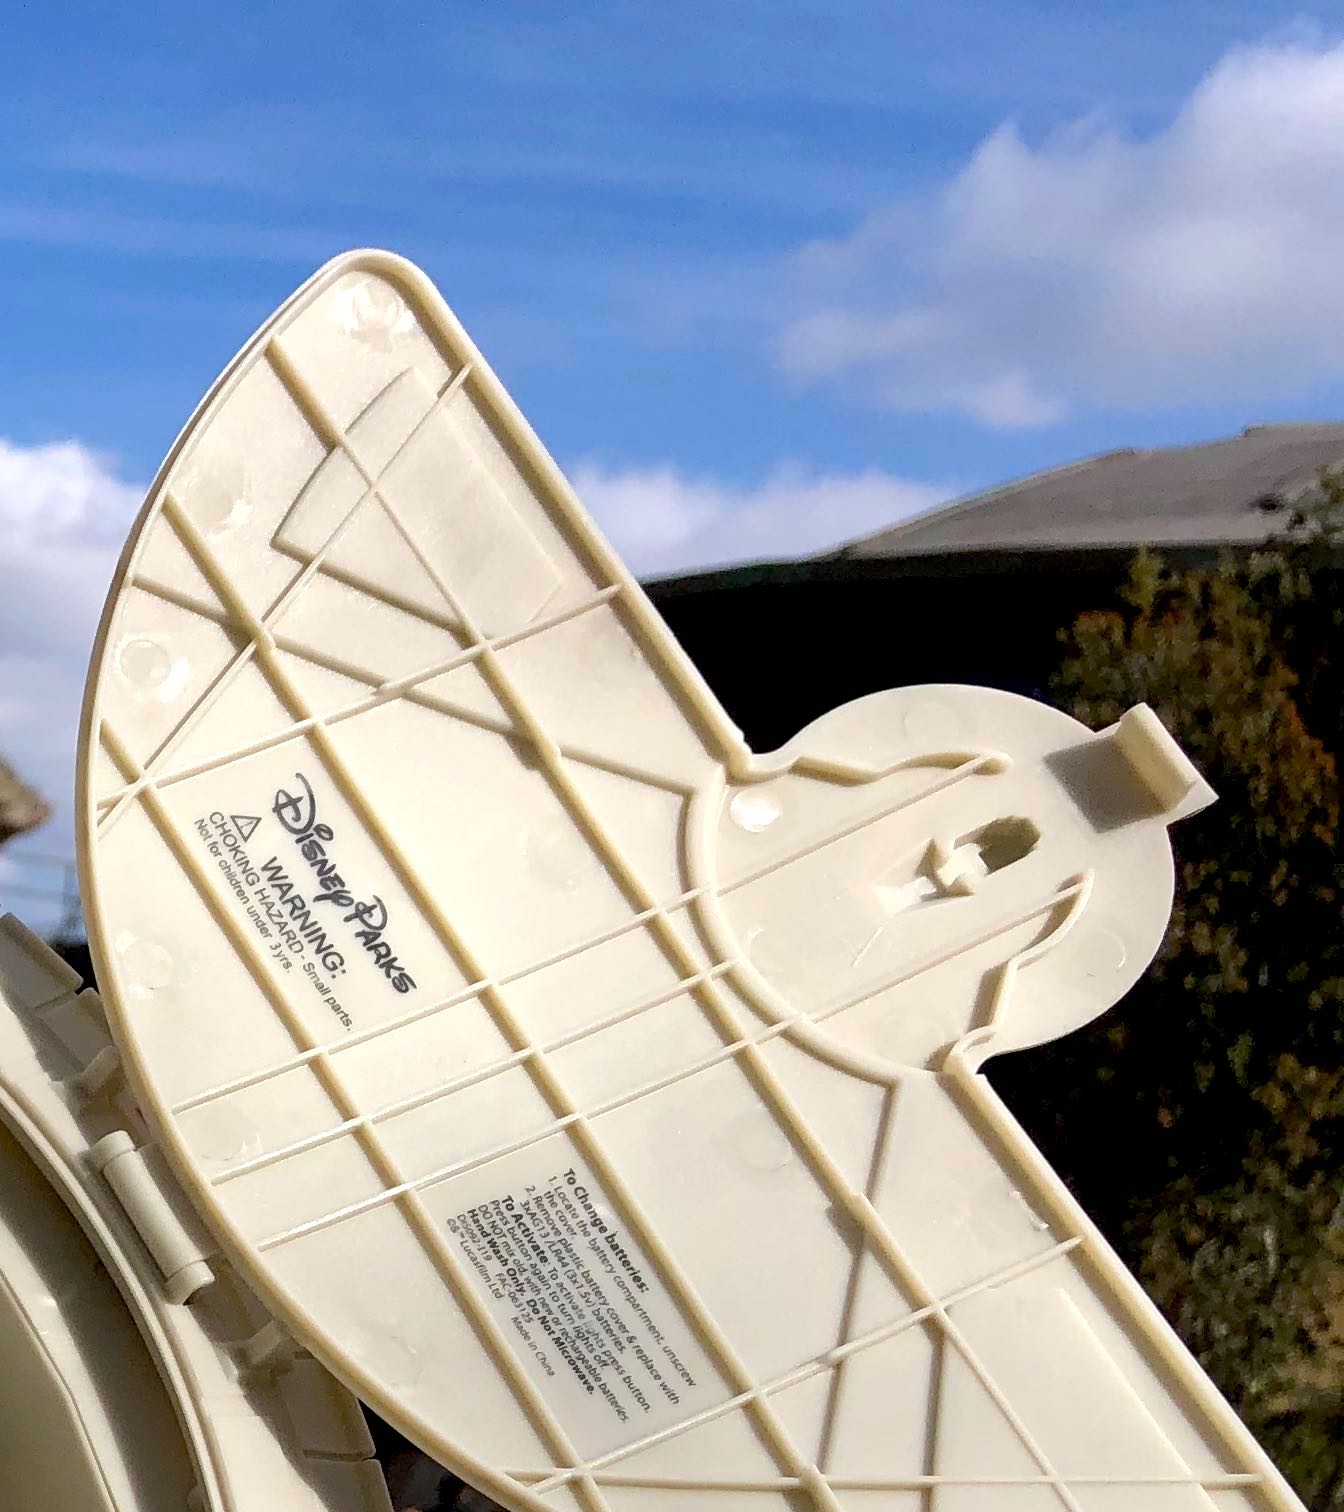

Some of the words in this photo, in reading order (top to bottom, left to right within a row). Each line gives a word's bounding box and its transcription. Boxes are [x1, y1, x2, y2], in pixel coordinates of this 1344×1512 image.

[193, 818, 213, 841] Not
[206, 840, 223, 859] for
[216, 857, 251, 905] children
[245, 904, 274, 939] under
[271, 949, 296, 974] yrs.
[206, 809, 262, 887] CHOKING
[252, 886, 305, 955] HAZARD
[301, 960, 331, 996] Small
[322, 994, 357, 1033] parts.
[258, 855, 351, 980] WARNING:
[541, 1190, 560, 1209] the
[560, 1167, 580, 1186] To
[568, 1184, 612, 1235] Change
[458, 1238, 494, 1283] Lucasfilm
[509, 1315, 533, 1341] Made
[533, 1350, 557, 1376] China
[465, 1208, 492, 1238] Hand
[484, 1237, 511, 1267] Wash
[502, 1266, 530, 1297] Only.
[525, 1297, 543, 1315] Do
[536, 1315, 557, 1336] Not
[551, 1335, 598, 1395] Microwave.
[476, 1203, 494, 1220] DO
[486, 1219, 507, 1241] NOT
[500, 1240, 517, 1257] mix
[523, 1275, 543, 1296] with
[537, 1296, 555, 1316] new
[557, 1326, 603, 1383] rechargeable
[487, 1199, 512, 1226] Press
[505, 1226, 535, 1261] button
[526, 1261, 553, 1291] again
[556, 1302, 577, 1325] turn
[570, 1324, 598, 1355] lights
[498, 1194, 518, 1212] To
[509, 1211, 554, 1267] Activate:
[545, 1265, 562, 1281] To
[554, 1280, 589, 1320] activate
[600, 1349, 626, 1376] press
[530, 1194, 565, 1237] Remove
[557, 1236, 587, 1270] plastic
[578, 1269, 612, 1307] battery
[604, 1306, 630, 1335] cover
[629, 1343, 664, 1382] replace
[657, 1380, 681, 1405] with
[551, 1185, 582, 1220] Locate
[574, 1219, 594, 1238] the
[585, 1237, 619, 1275] battery
[661, 1344, 696, 1387] unscrew
[590, 1307, 629, 1354] batteries.
[603, 1232, 652, 1293] batteries:
